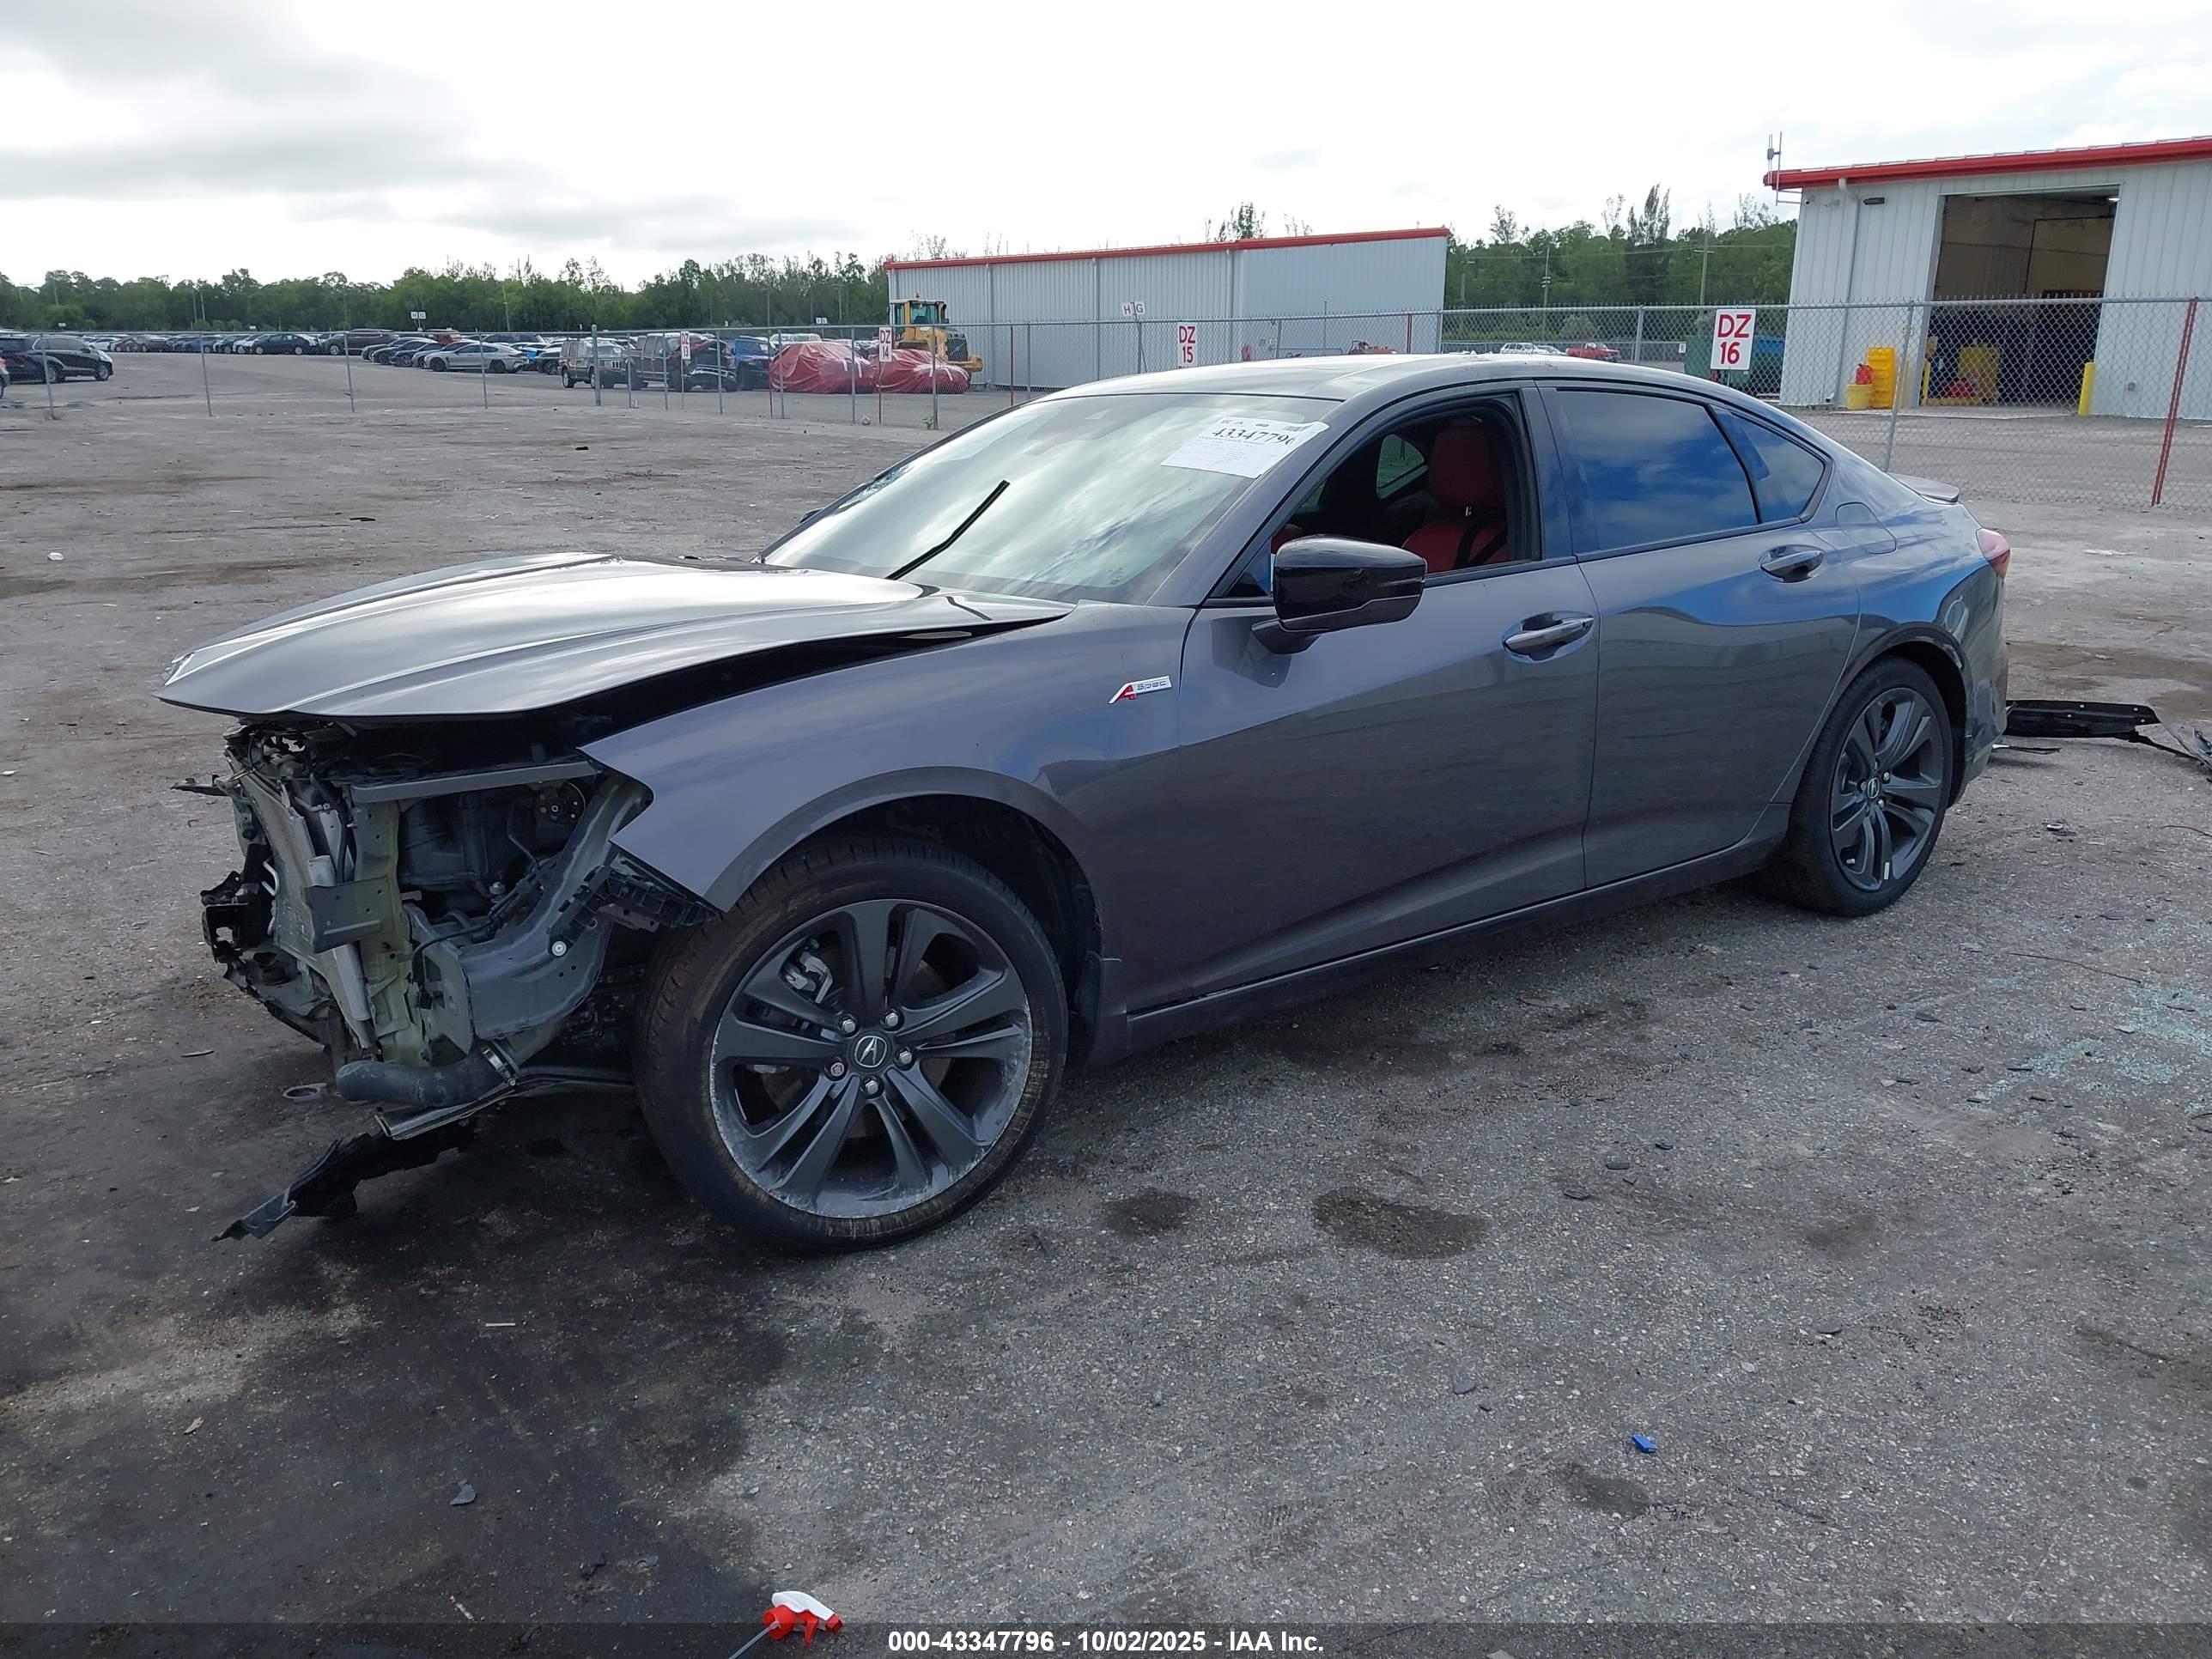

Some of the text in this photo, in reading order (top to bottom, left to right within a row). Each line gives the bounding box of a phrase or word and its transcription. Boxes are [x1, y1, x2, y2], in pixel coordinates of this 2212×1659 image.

[1123, 303, 1144, 315] H G
[1717, 314, 1752, 338] DZ
[681, 332, 690, 345] DZ
[879, 329, 891, 344] DZ
[1179, 325, 1196, 344] DZ
[684, 345, 689, 357] 13
[882, 345, 889, 359] 14
[1182, 346, 1194, 363] 15
[1720, 341, 1741, 365] 16
